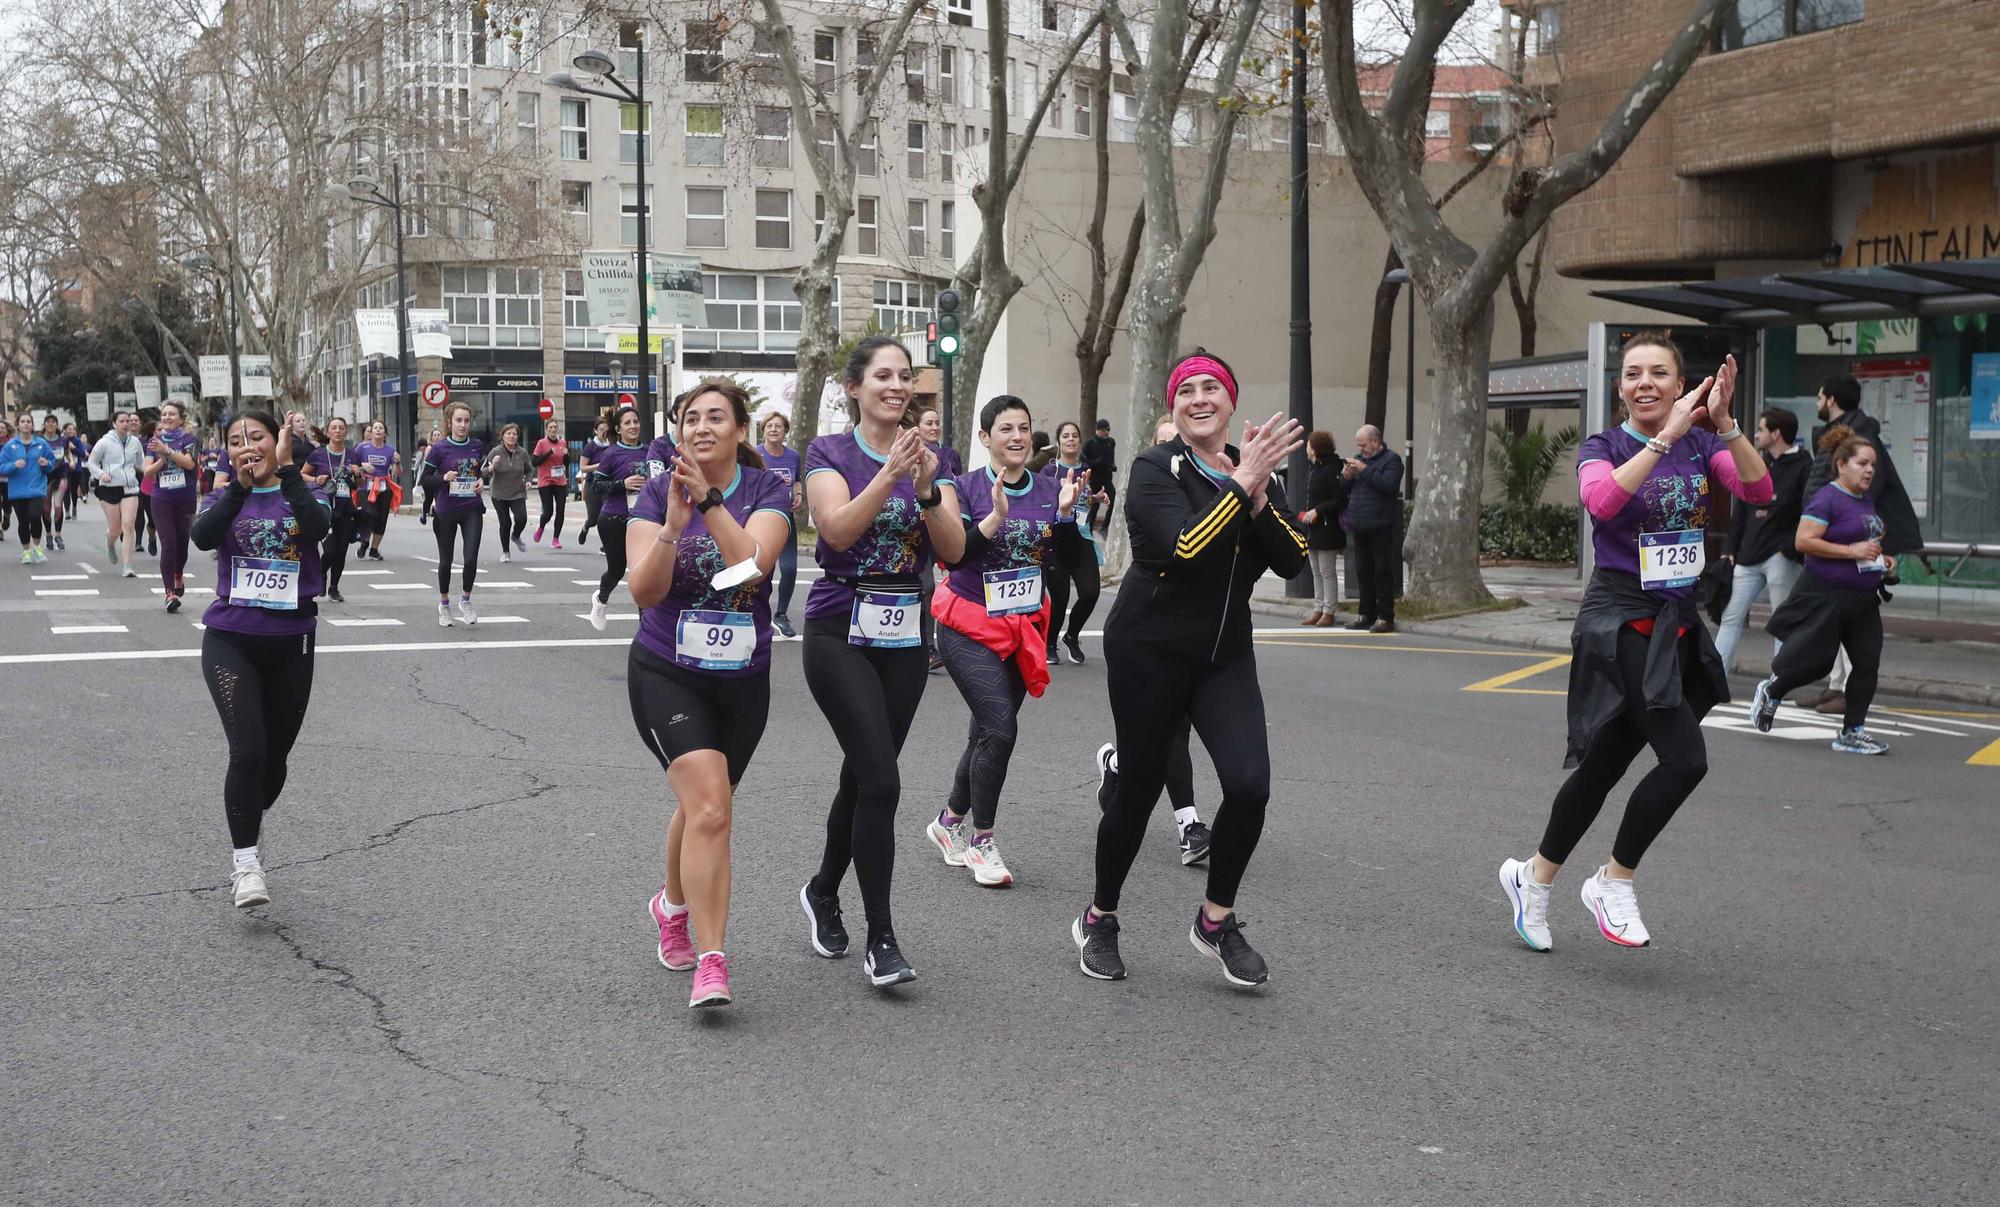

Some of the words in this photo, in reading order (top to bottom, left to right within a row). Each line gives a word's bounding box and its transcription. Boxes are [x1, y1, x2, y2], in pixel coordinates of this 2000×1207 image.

[589, 257, 628, 267] Oteiza
[587, 269, 634, 279] Chillida
[450, 377, 479, 385] BMC
[164, 474, 181, 483] 1707
[1656, 545, 1697, 567] 1236
[245, 571, 288, 590] 1055
[998, 579, 1035, 599] 1237
[879, 608, 904, 627] 39
[705, 626, 734, 647] 99
